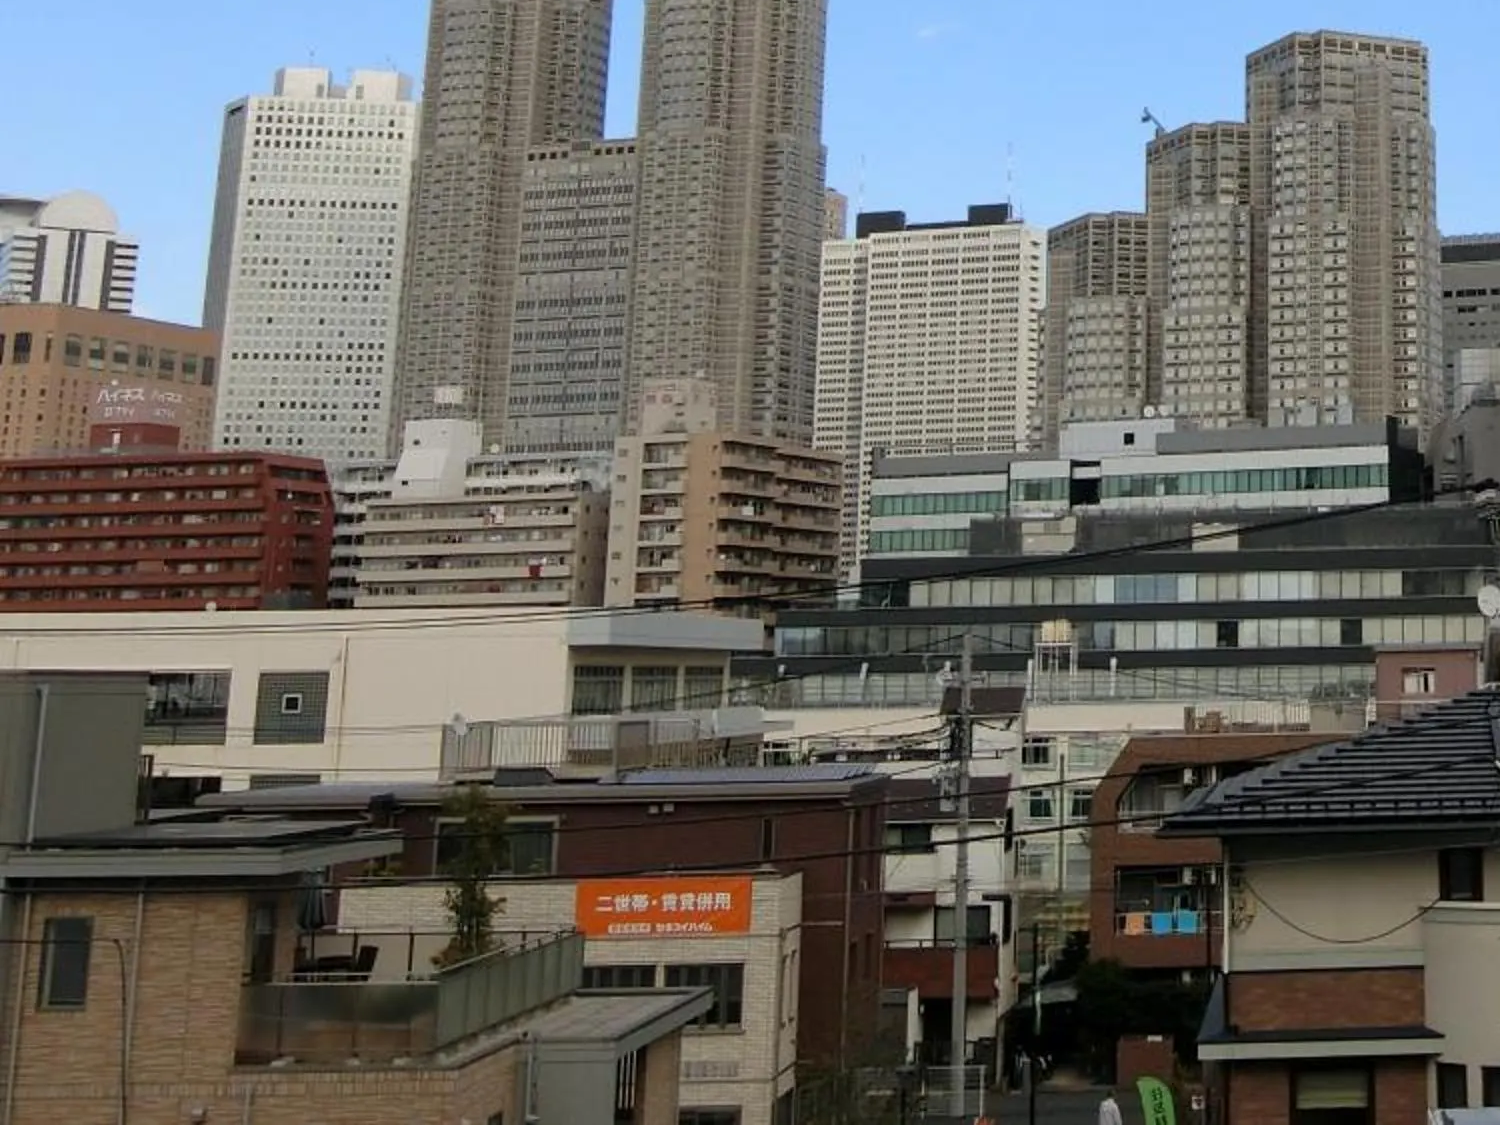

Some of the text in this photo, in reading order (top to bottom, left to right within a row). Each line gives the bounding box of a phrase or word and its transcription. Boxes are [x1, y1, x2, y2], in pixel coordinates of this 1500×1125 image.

[595, 892, 732, 912] 二世帯・賃貸併用
